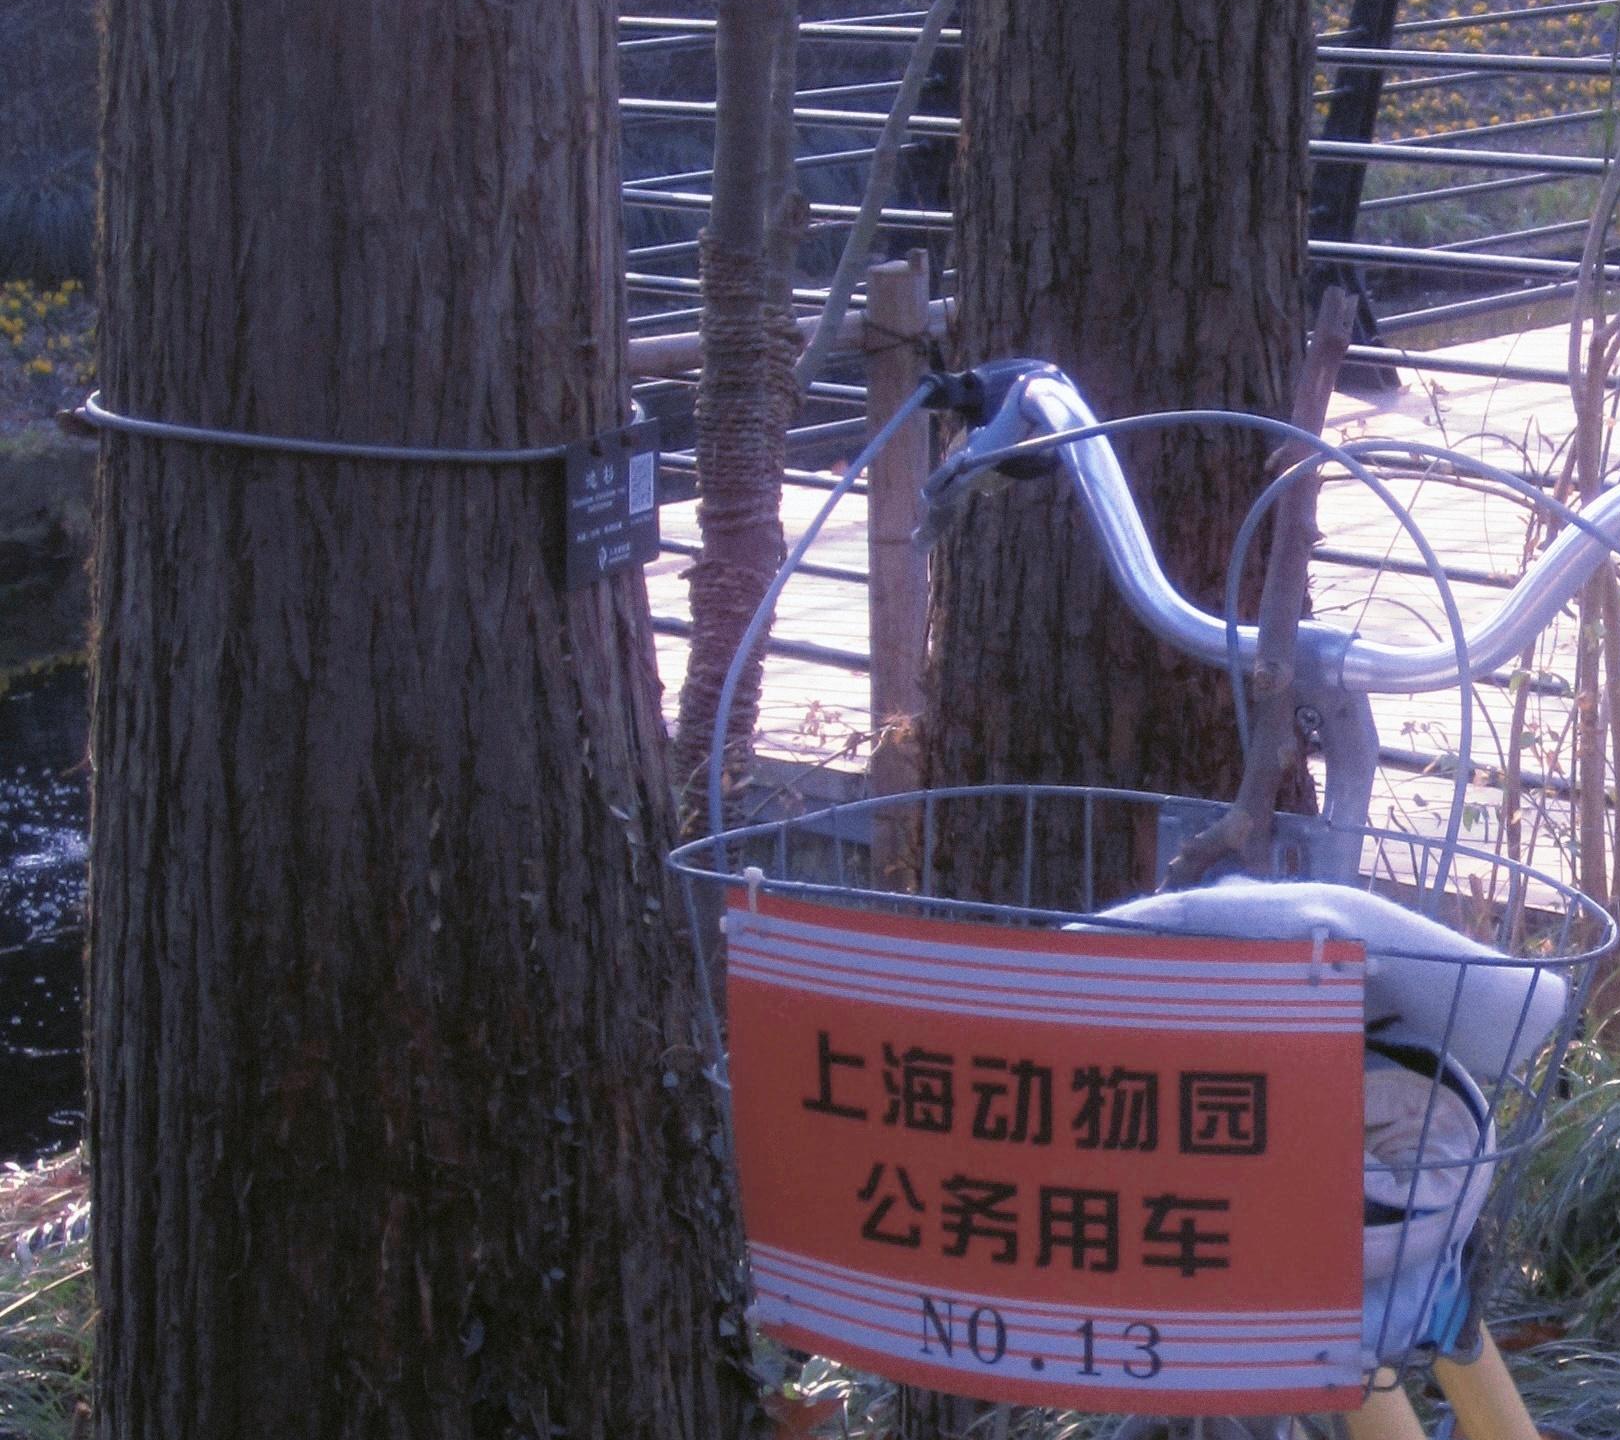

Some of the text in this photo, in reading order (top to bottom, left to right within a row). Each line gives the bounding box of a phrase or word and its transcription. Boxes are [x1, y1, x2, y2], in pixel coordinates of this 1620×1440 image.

[804, 1031, 1267, 1155] 上海动物园
[857, 1162, 1231, 1276] 公务用车
[919, 1293, 1163, 1380] NO.13
